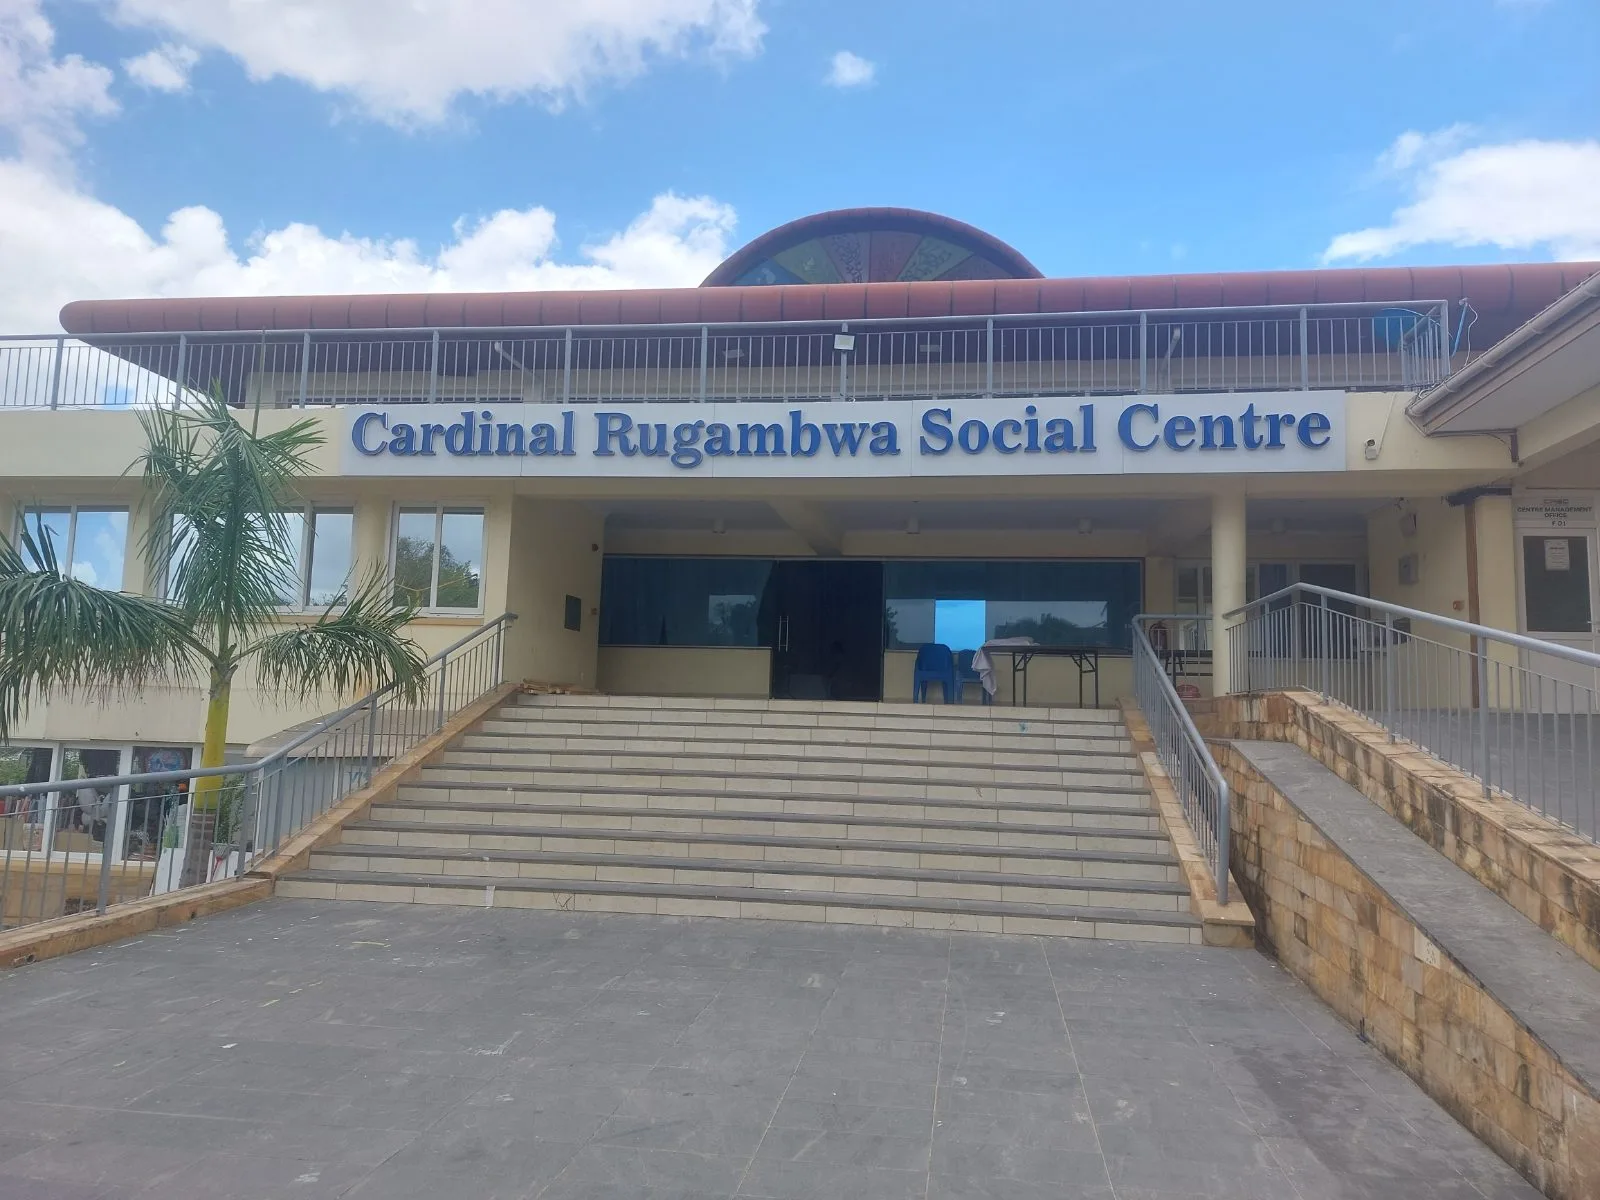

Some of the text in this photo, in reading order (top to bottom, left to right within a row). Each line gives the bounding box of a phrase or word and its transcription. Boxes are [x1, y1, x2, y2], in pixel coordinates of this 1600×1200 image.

[351, 402, 1332, 468] Cardinal Rugambwa Social Centre
